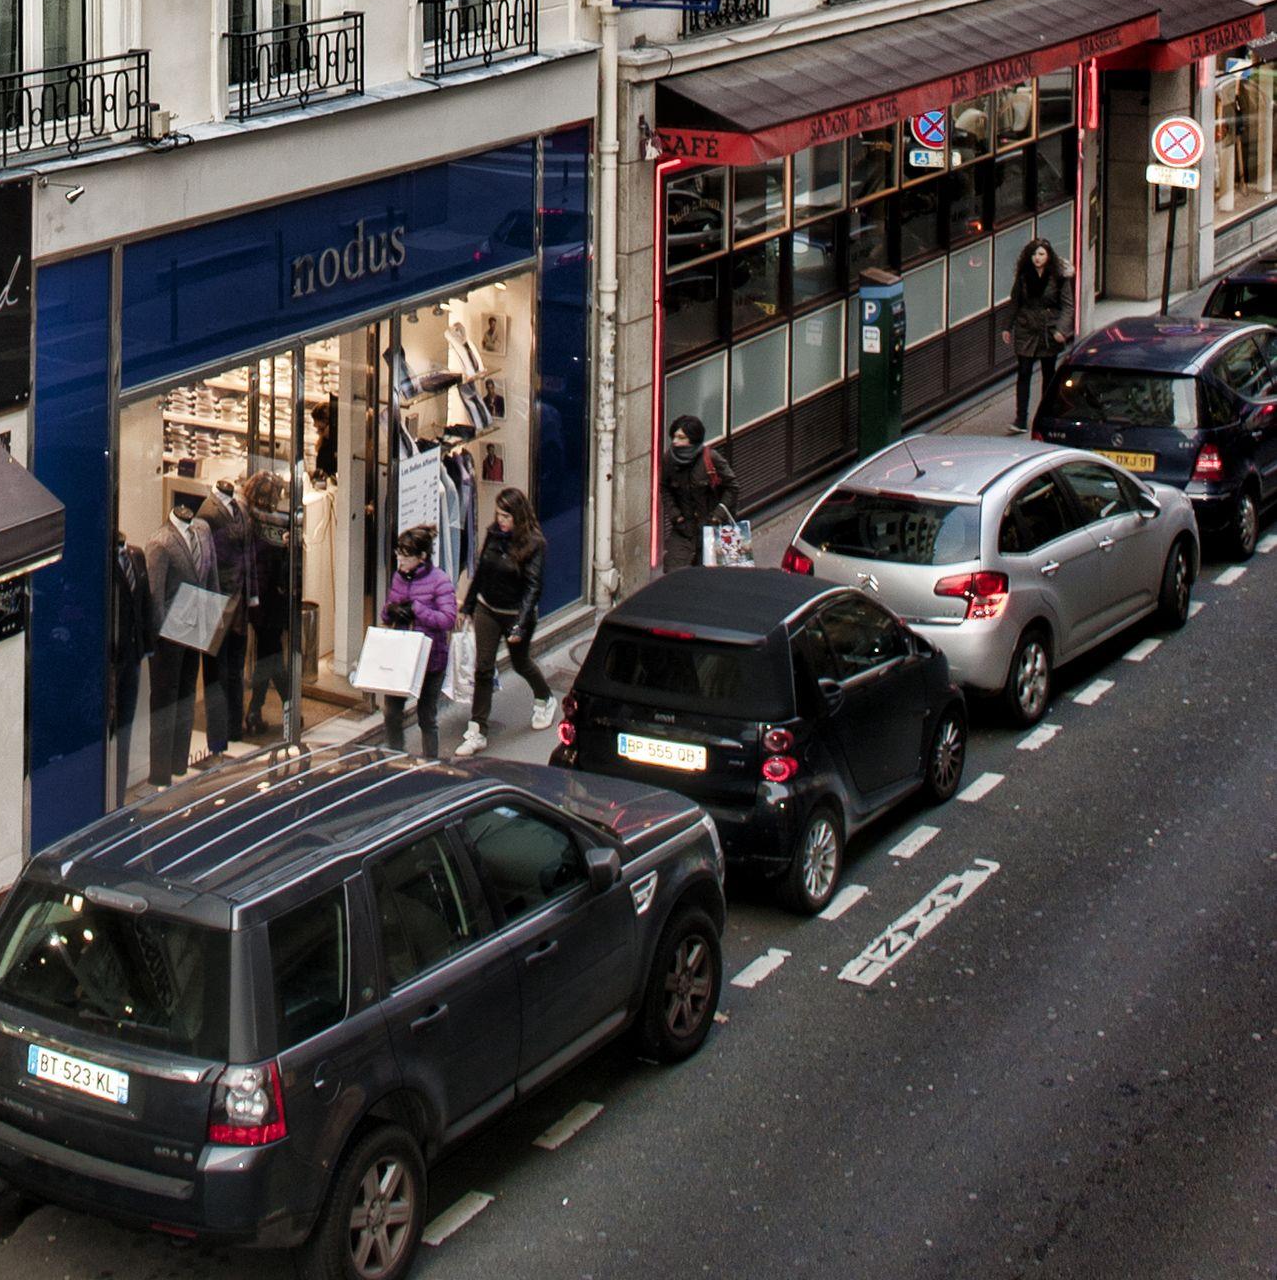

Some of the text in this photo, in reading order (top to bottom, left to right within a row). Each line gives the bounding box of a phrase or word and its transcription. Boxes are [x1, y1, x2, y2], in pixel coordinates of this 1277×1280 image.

[1186, 37, 1202, 61] LE
[291, 219, 406, 298] nodus
[648, 742, 673, 760] 555
